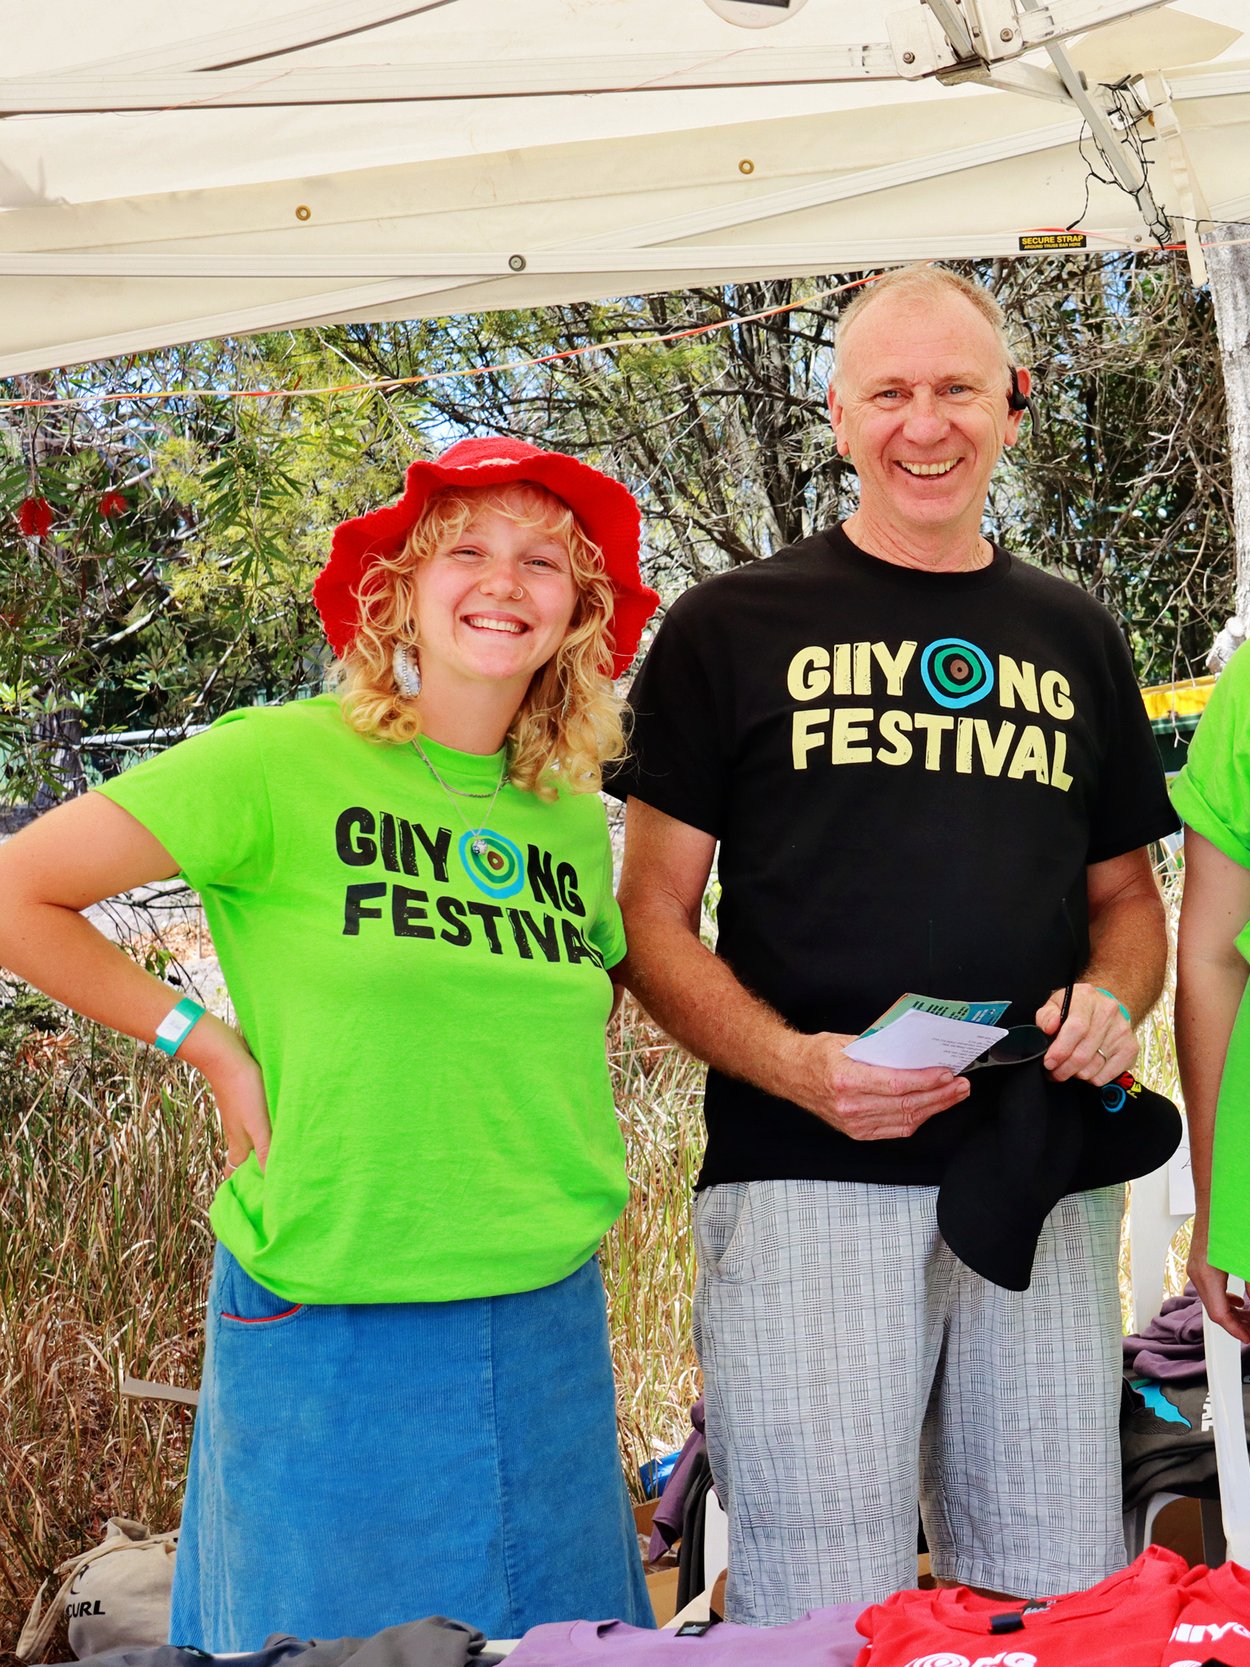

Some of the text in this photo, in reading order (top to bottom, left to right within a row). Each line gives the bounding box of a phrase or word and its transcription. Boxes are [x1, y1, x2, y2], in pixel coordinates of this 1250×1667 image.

[1022, 235, 1083, 245] SECURE STRAP
[792, 708, 1074, 791] FESTIVAL
[342, 882, 605, 969] FESTIVA
[66, 1600, 105, 1618] CURL
